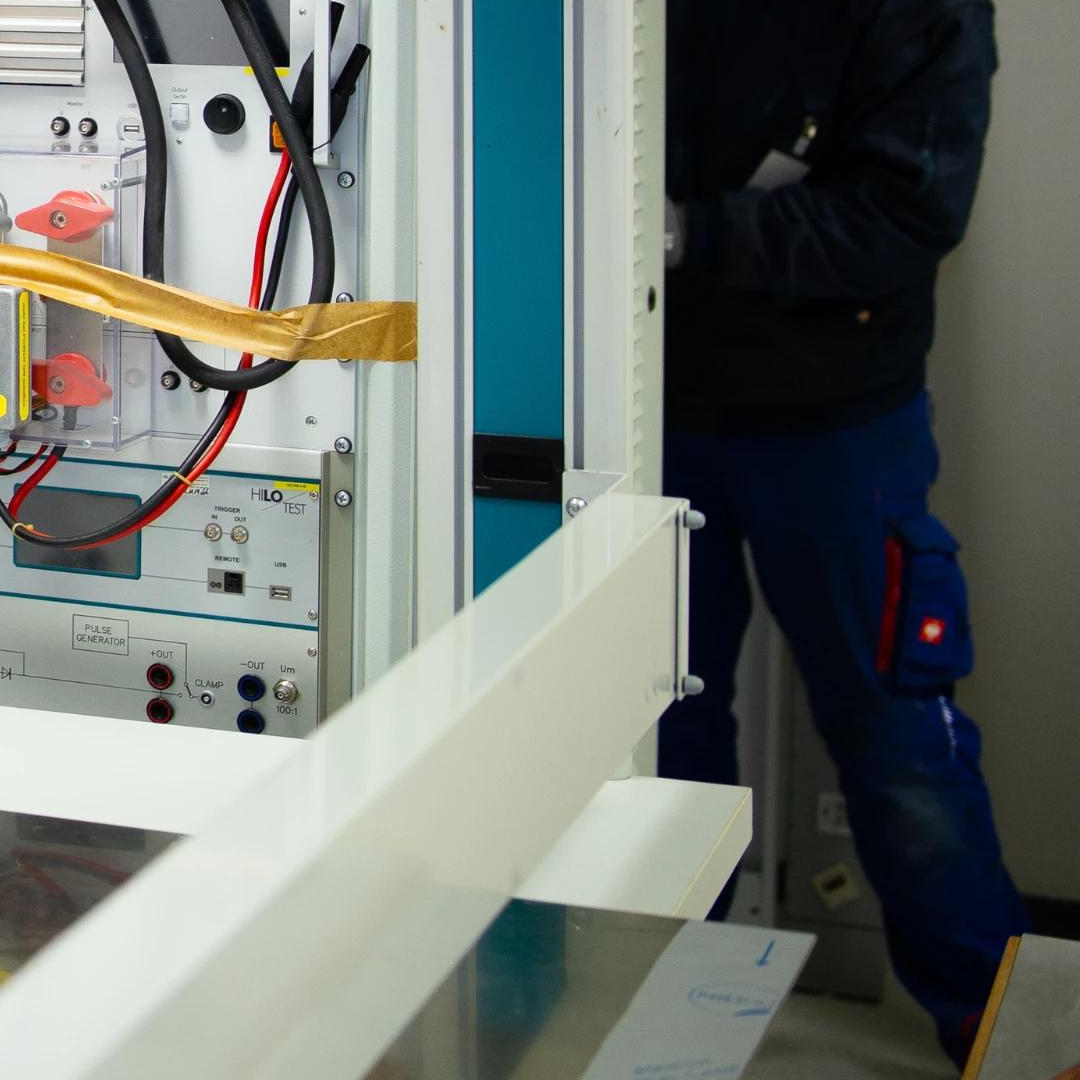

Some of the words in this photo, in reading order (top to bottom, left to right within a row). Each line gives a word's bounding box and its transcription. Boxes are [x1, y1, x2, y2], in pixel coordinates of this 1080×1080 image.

[251, 488, 283, 503] HILO
[214, 506, 241, 514] TRIGGER
[284, 502, 307, 515] TEST
[84, 624, 113, 635] PULSE
[76, 634, 126, 647] GENERATOR
[150, 650, 174, 659] +OUT
[240, 661, 265, 670] -OUT
[280, 665, 296, 674] Um
[195, 679, 224, 689] CLAMP
[276, 706, 298, 716] 100:1
